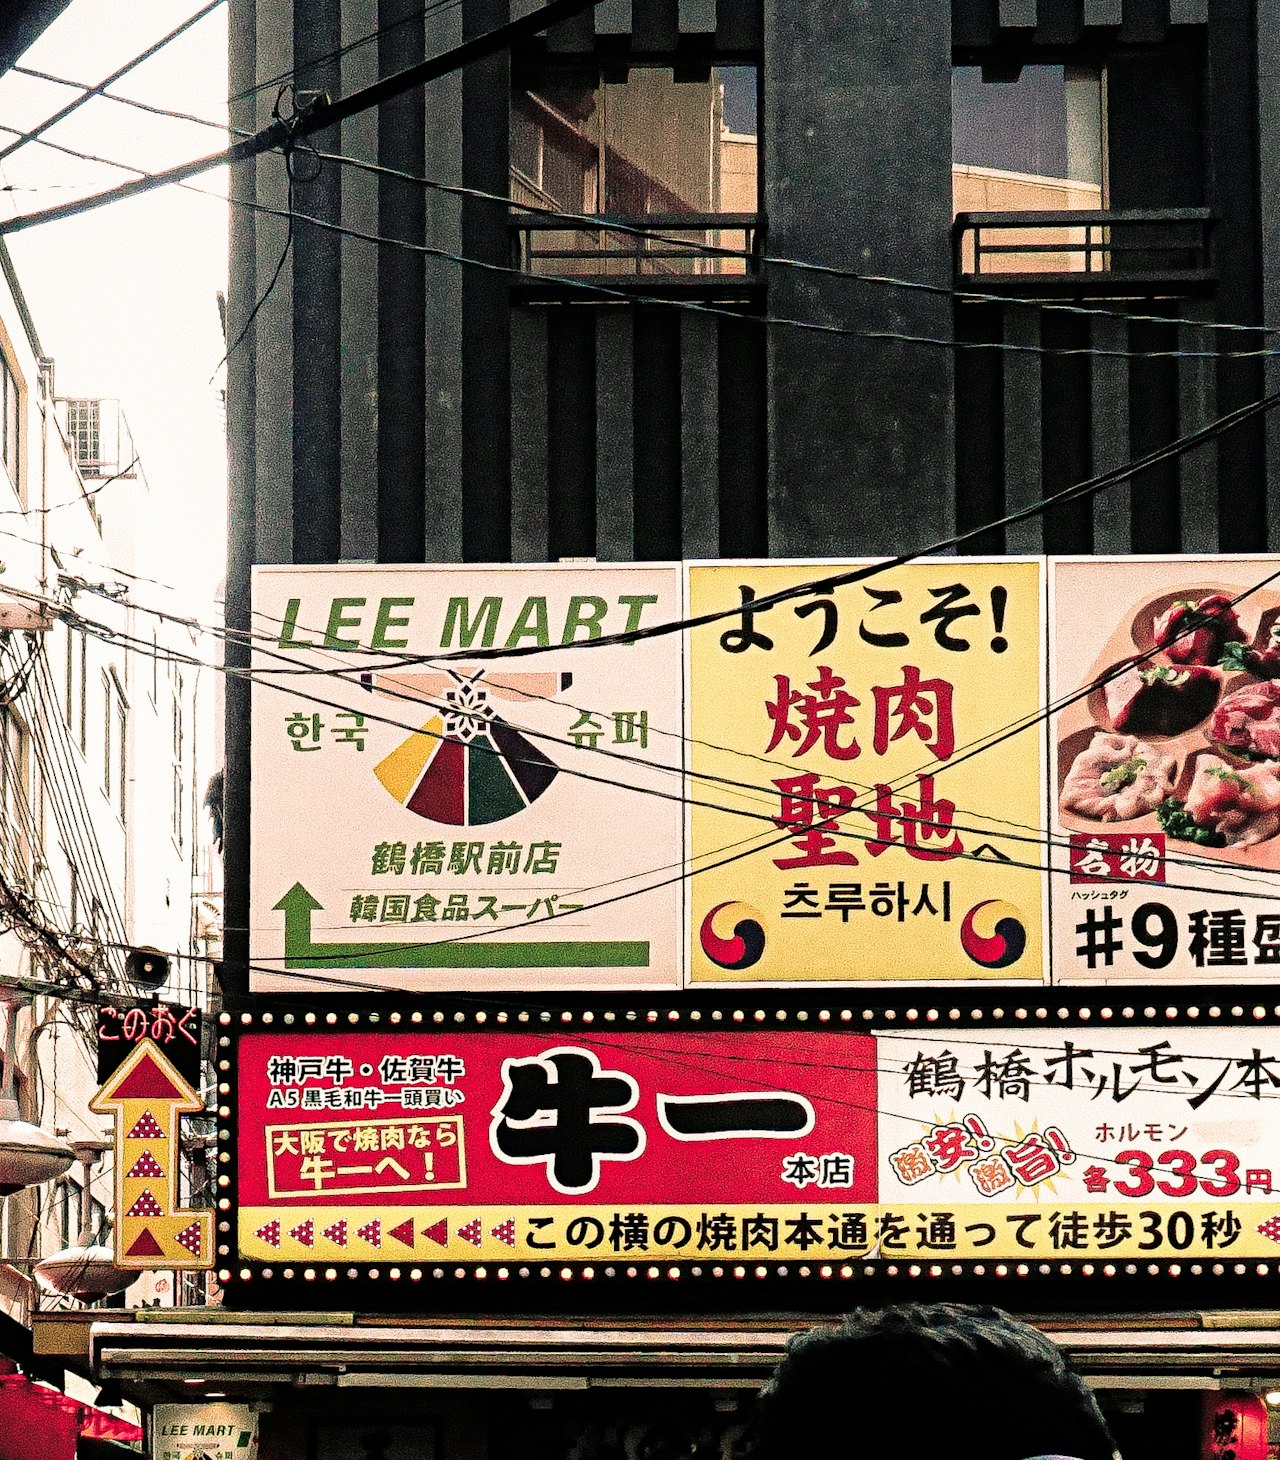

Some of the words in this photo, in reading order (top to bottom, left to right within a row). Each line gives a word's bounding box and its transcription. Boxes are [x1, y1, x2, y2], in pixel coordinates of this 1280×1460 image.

[278, 598, 415, 649] LEE
[439, 595, 657, 648] MART
[284, 711, 370, 752] 한국
[567, 709, 650, 751] 슈퍼
[764, 666, 955, 761] 焼肉
[371, 840, 562, 875] 鶴橋駅前店
[350, 893, 585, 924] 韓国食品スーパー
[781, 880, 952, 922] 츠루하시
[268, 1055, 466, 1086] 神戸牛・佐賀牛
[273, 1123, 458, 1156] 大阪で焼肉なら
[490, 1047, 814, 1194] 牛一
[1095, 1122, 1189, 1143] ホルモン
[783, 1153, 854, 1189] 本店
[1083, 1149, 1272, 1198] 各333円
[526, 1211, 1242, 1252] この横の焼肉本通を通って徒歩30秒
[162, 1425, 189, 1436] LEE
[193, 1424, 236, 1436] MART
